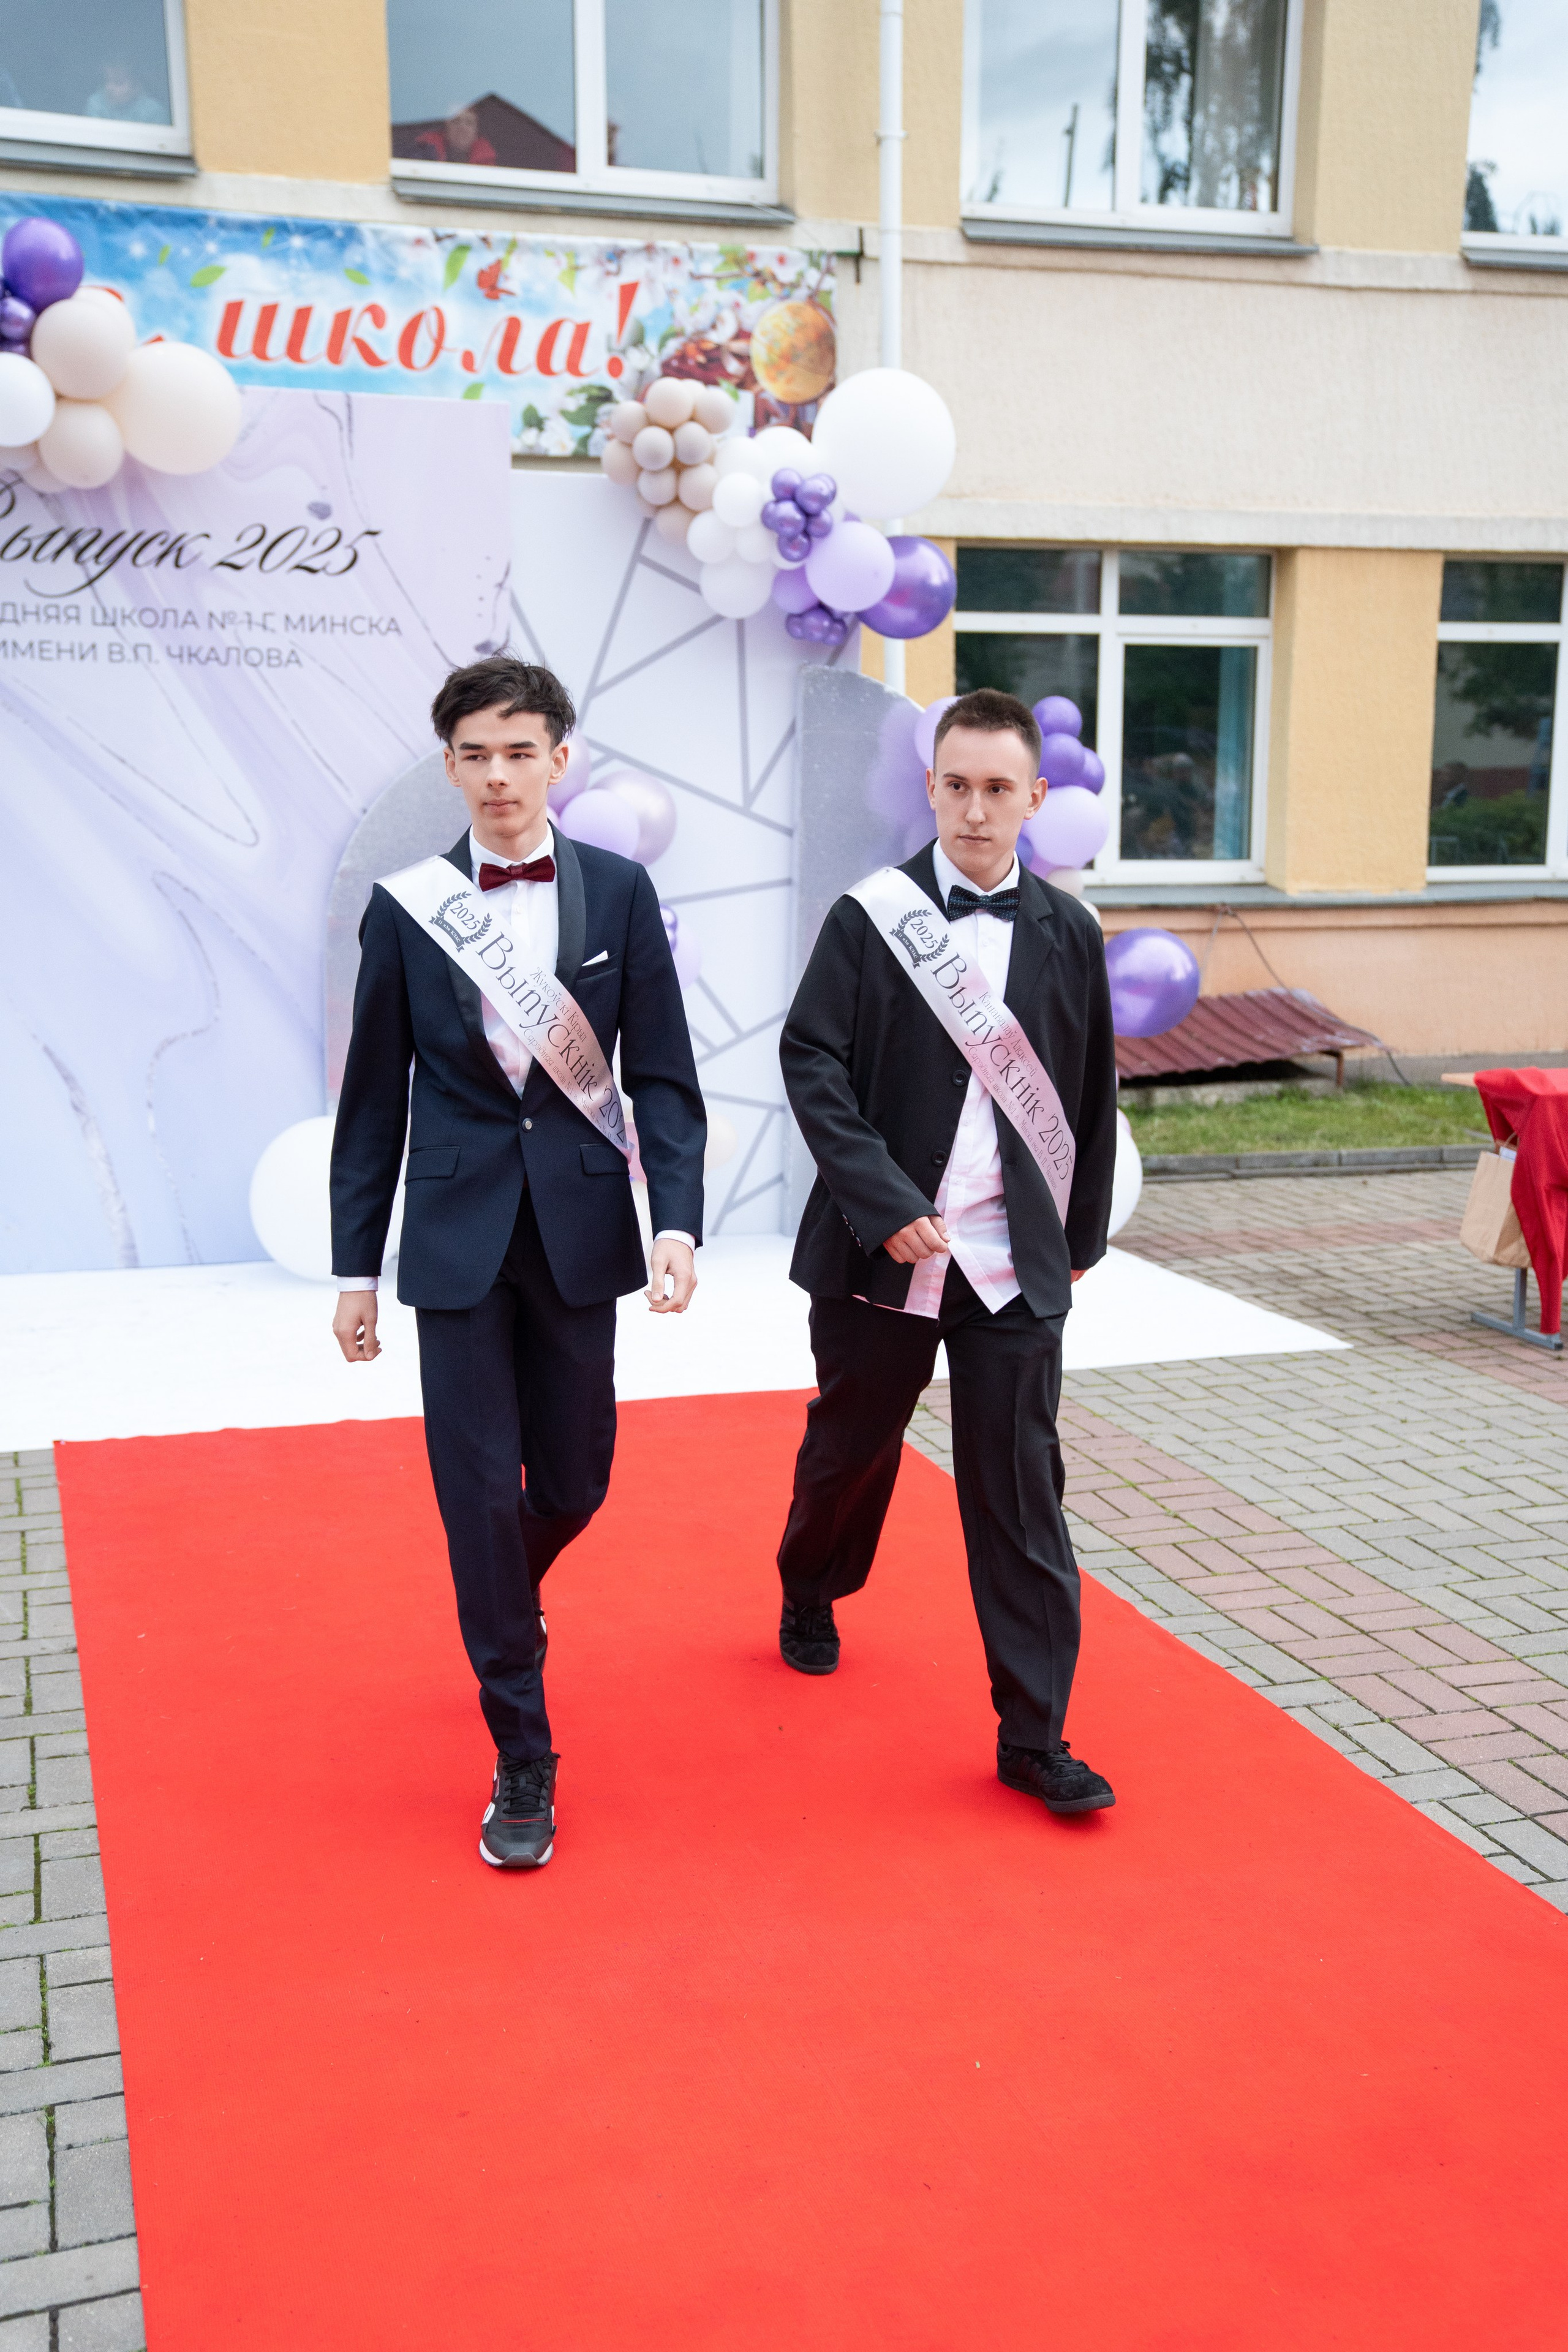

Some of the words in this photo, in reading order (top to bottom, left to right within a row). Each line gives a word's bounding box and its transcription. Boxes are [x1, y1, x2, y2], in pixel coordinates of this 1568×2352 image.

[216, 280, 640, 380] школа!
[209, 522, 382, 576] 2025
[91, 606, 200, 628] ШКОЛА
[283, 614, 403, 636] МИНСКА
[107, 641, 160, 664] В.П.
[166, 644, 303, 668] ЧКАЛОВА
[450, 902, 481, 930] 2025
[450, 930, 461, 943] КЛАС
[910, 918, 938, 949] 2025
[908, 944, 919, 959] КЛАС
[475, 930, 597, 1101] Выпускнік
[530, 967, 571, 1016] Жукоўскі
[568, 1011, 587, 1042] Кірыл
[523, 1028, 554, 1066] Сярэдняя
[552, 1065, 567, 1085] школа
[979, 992, 1017, 1040] Канавалаў
[1011, 1038, 1038, 1077] Аляксей
[930, 951, 1044, 1125] Выпускнік
[1038, 1113, 1072, 1180] 2025
[968, 1047, 995, 1084] Сярэдняя
[992, 1083, 1007, 1103] школа
[1019, 1119, 1033, 1142] Мінска
